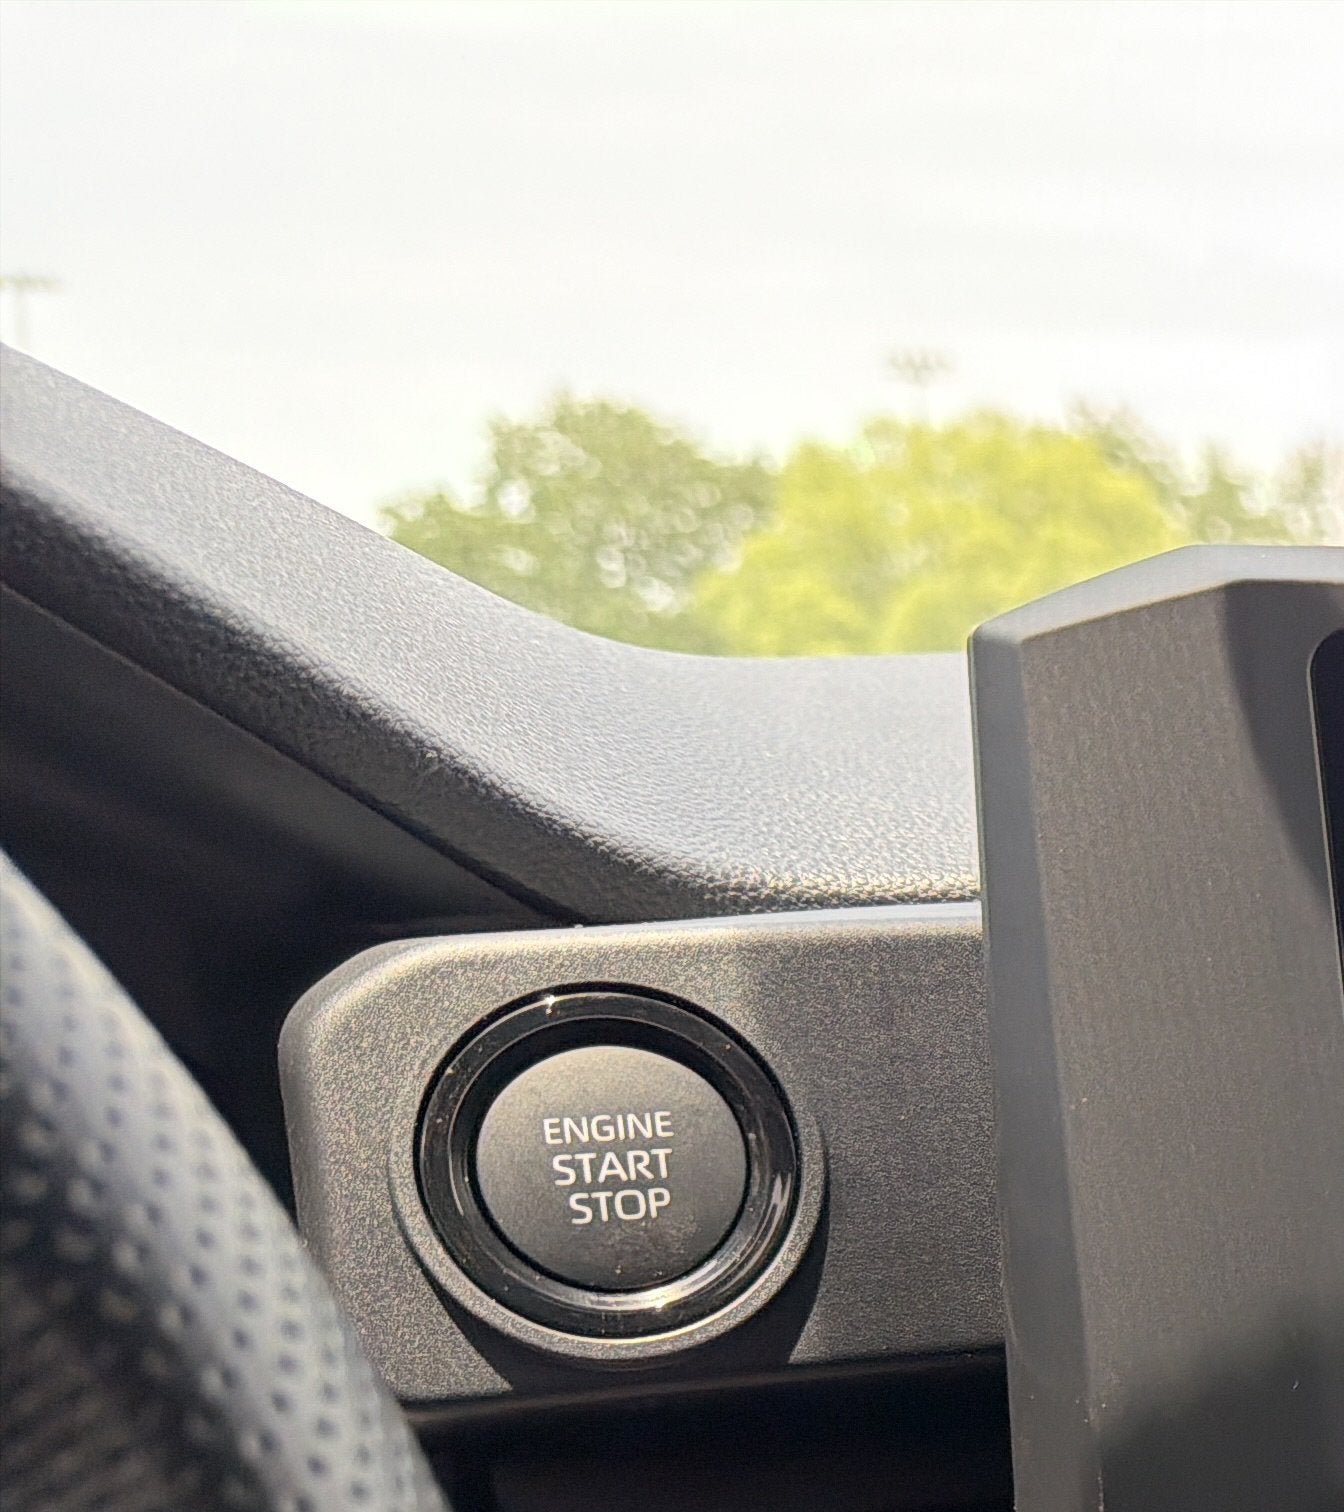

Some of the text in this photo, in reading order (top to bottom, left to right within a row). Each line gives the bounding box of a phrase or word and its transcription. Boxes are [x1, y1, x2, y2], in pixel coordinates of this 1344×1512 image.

[543, 1111, 674, 1145] ENGINE
[552, 1148, 673, 1186] START
[569, 1187, 671, 1225] STOP
